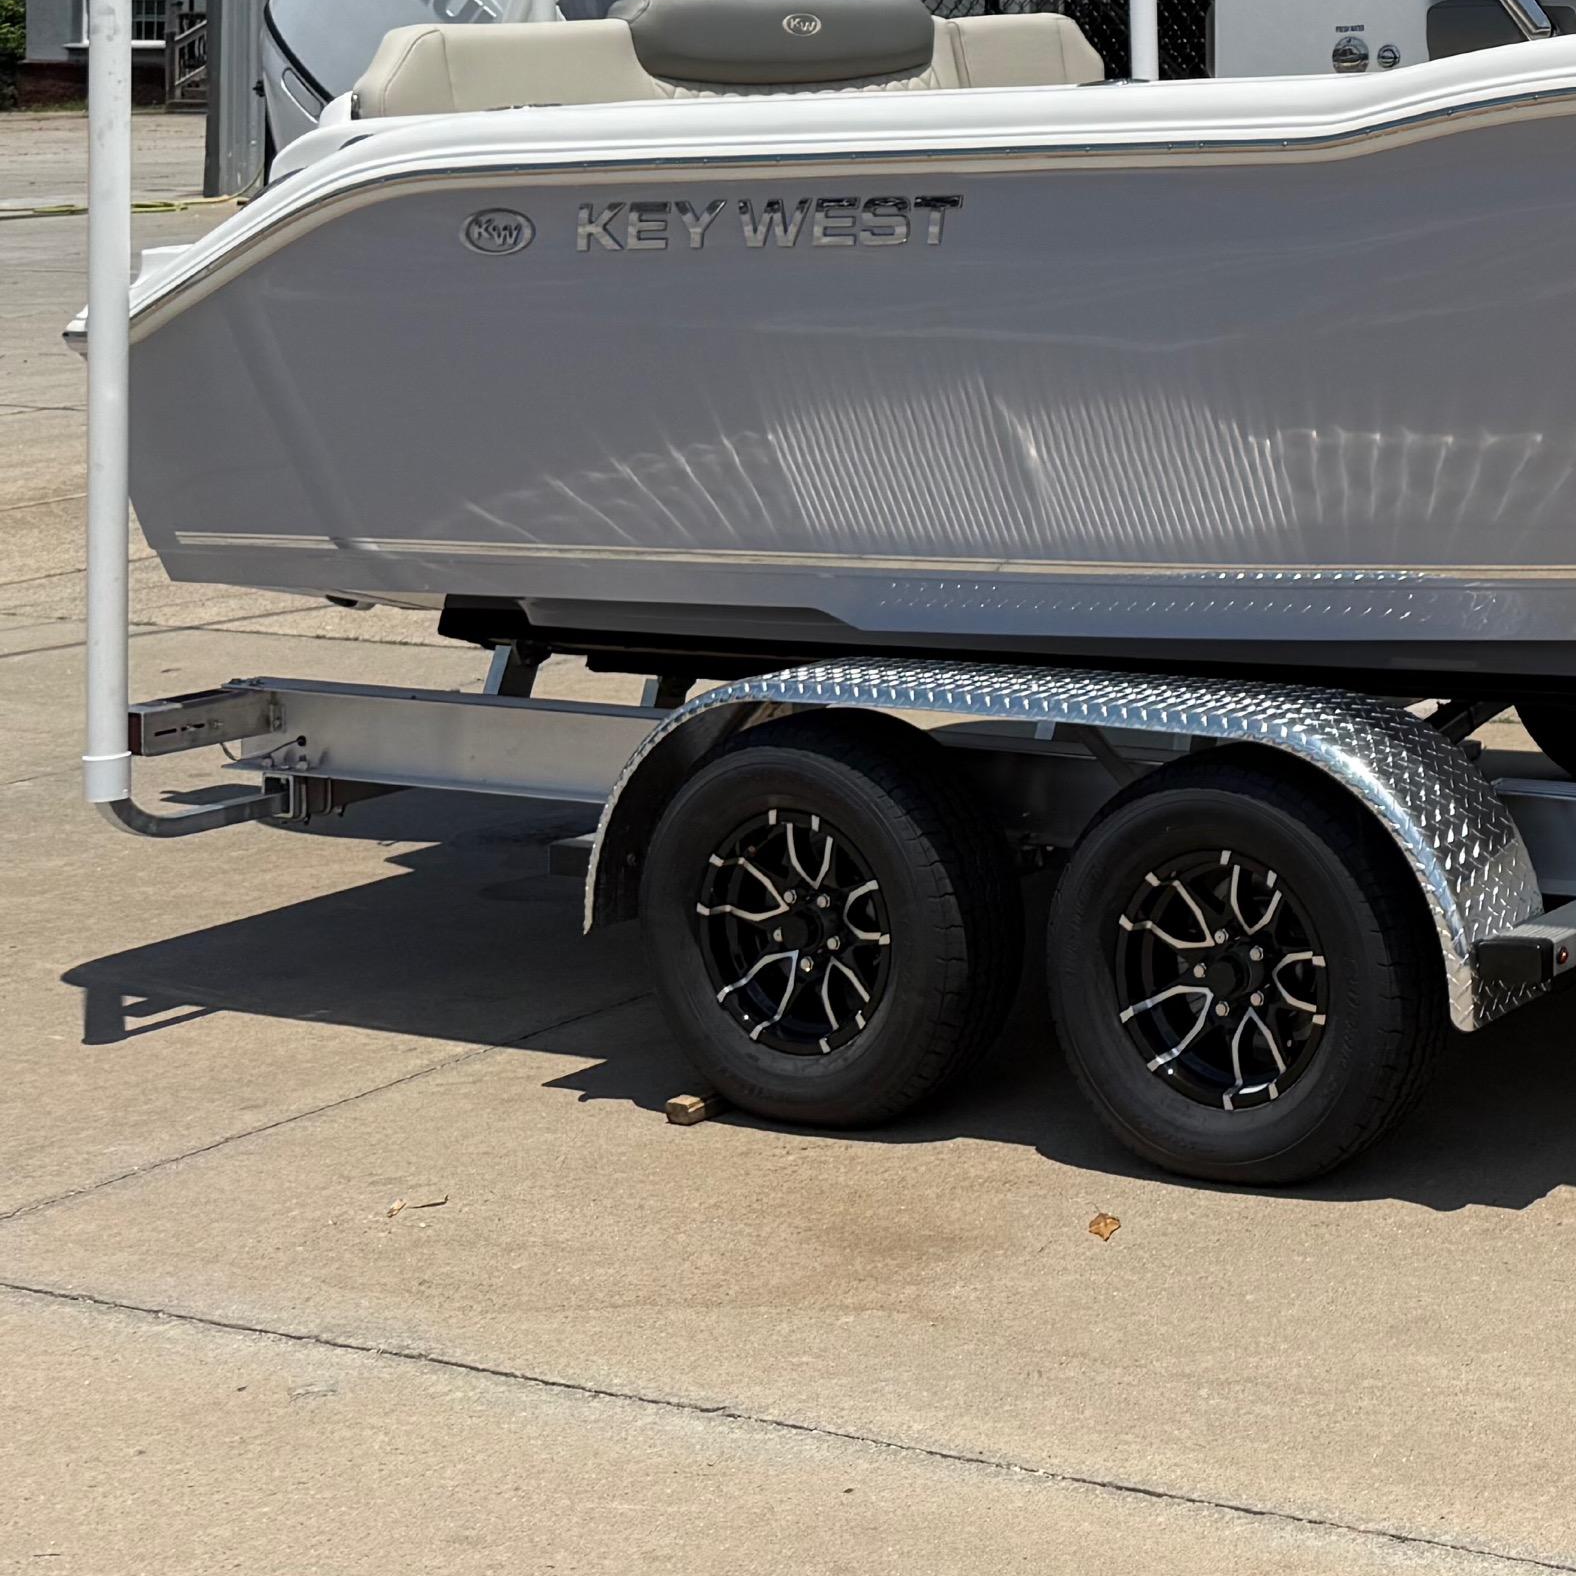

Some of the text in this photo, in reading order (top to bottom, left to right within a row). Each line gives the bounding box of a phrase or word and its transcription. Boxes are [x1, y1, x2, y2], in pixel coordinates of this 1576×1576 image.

[790, 18, 816, 31] KW
[576, 194, 966, 253] KEY WEST
